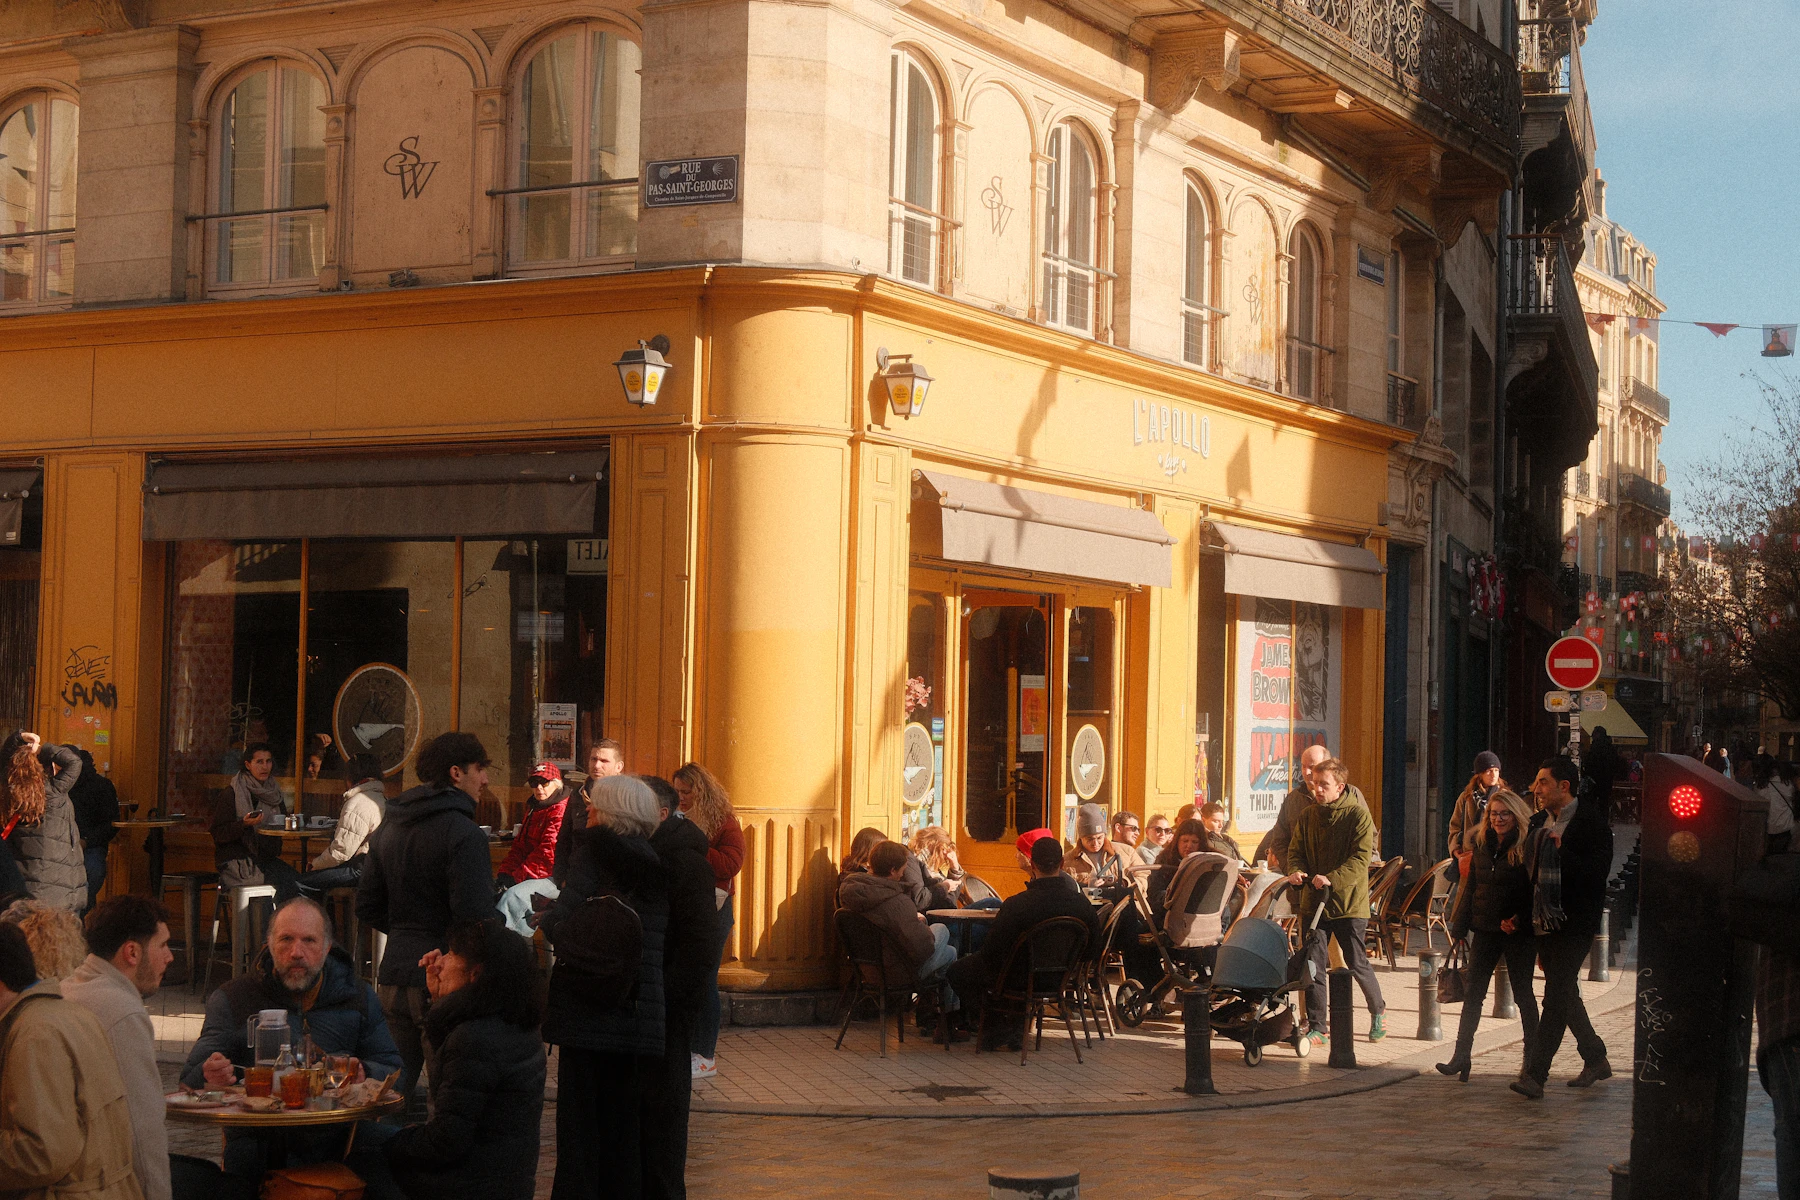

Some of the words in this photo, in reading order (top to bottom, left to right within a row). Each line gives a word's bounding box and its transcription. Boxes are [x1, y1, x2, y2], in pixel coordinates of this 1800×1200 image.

[681, 161, 701, 174] RUE
[648, 178, 734, 196] PAS-SAINT-GEORGES
[1134, 399, 1210, 459] L'APOLLO
[550, 711, 568, 720] APOLLO
[1249, 793, 1277, 811] THUR.
